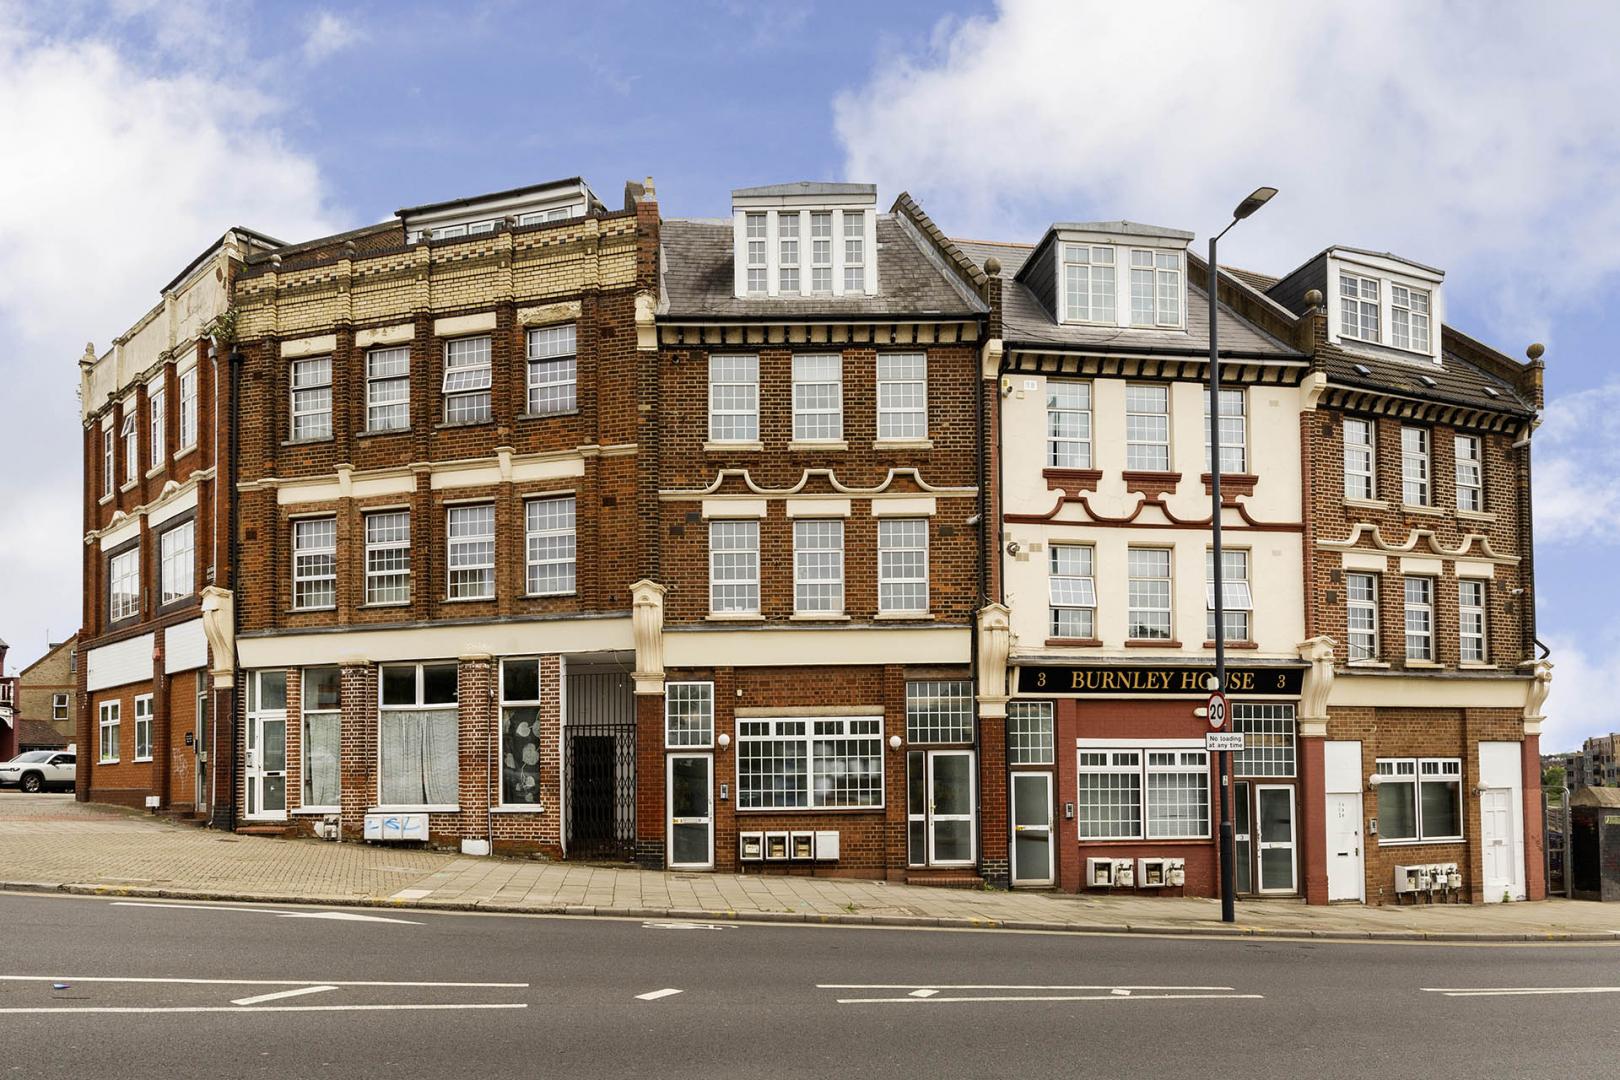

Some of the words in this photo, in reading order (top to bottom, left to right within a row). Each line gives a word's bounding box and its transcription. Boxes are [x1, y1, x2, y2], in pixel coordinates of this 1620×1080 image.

[1037, 672, 1046, 687] 3
[1071, 671, 1174, 689] BURNLEY
[1276, 674, 1286, 689] 3
[1210, 703, 1223, 719] 20
